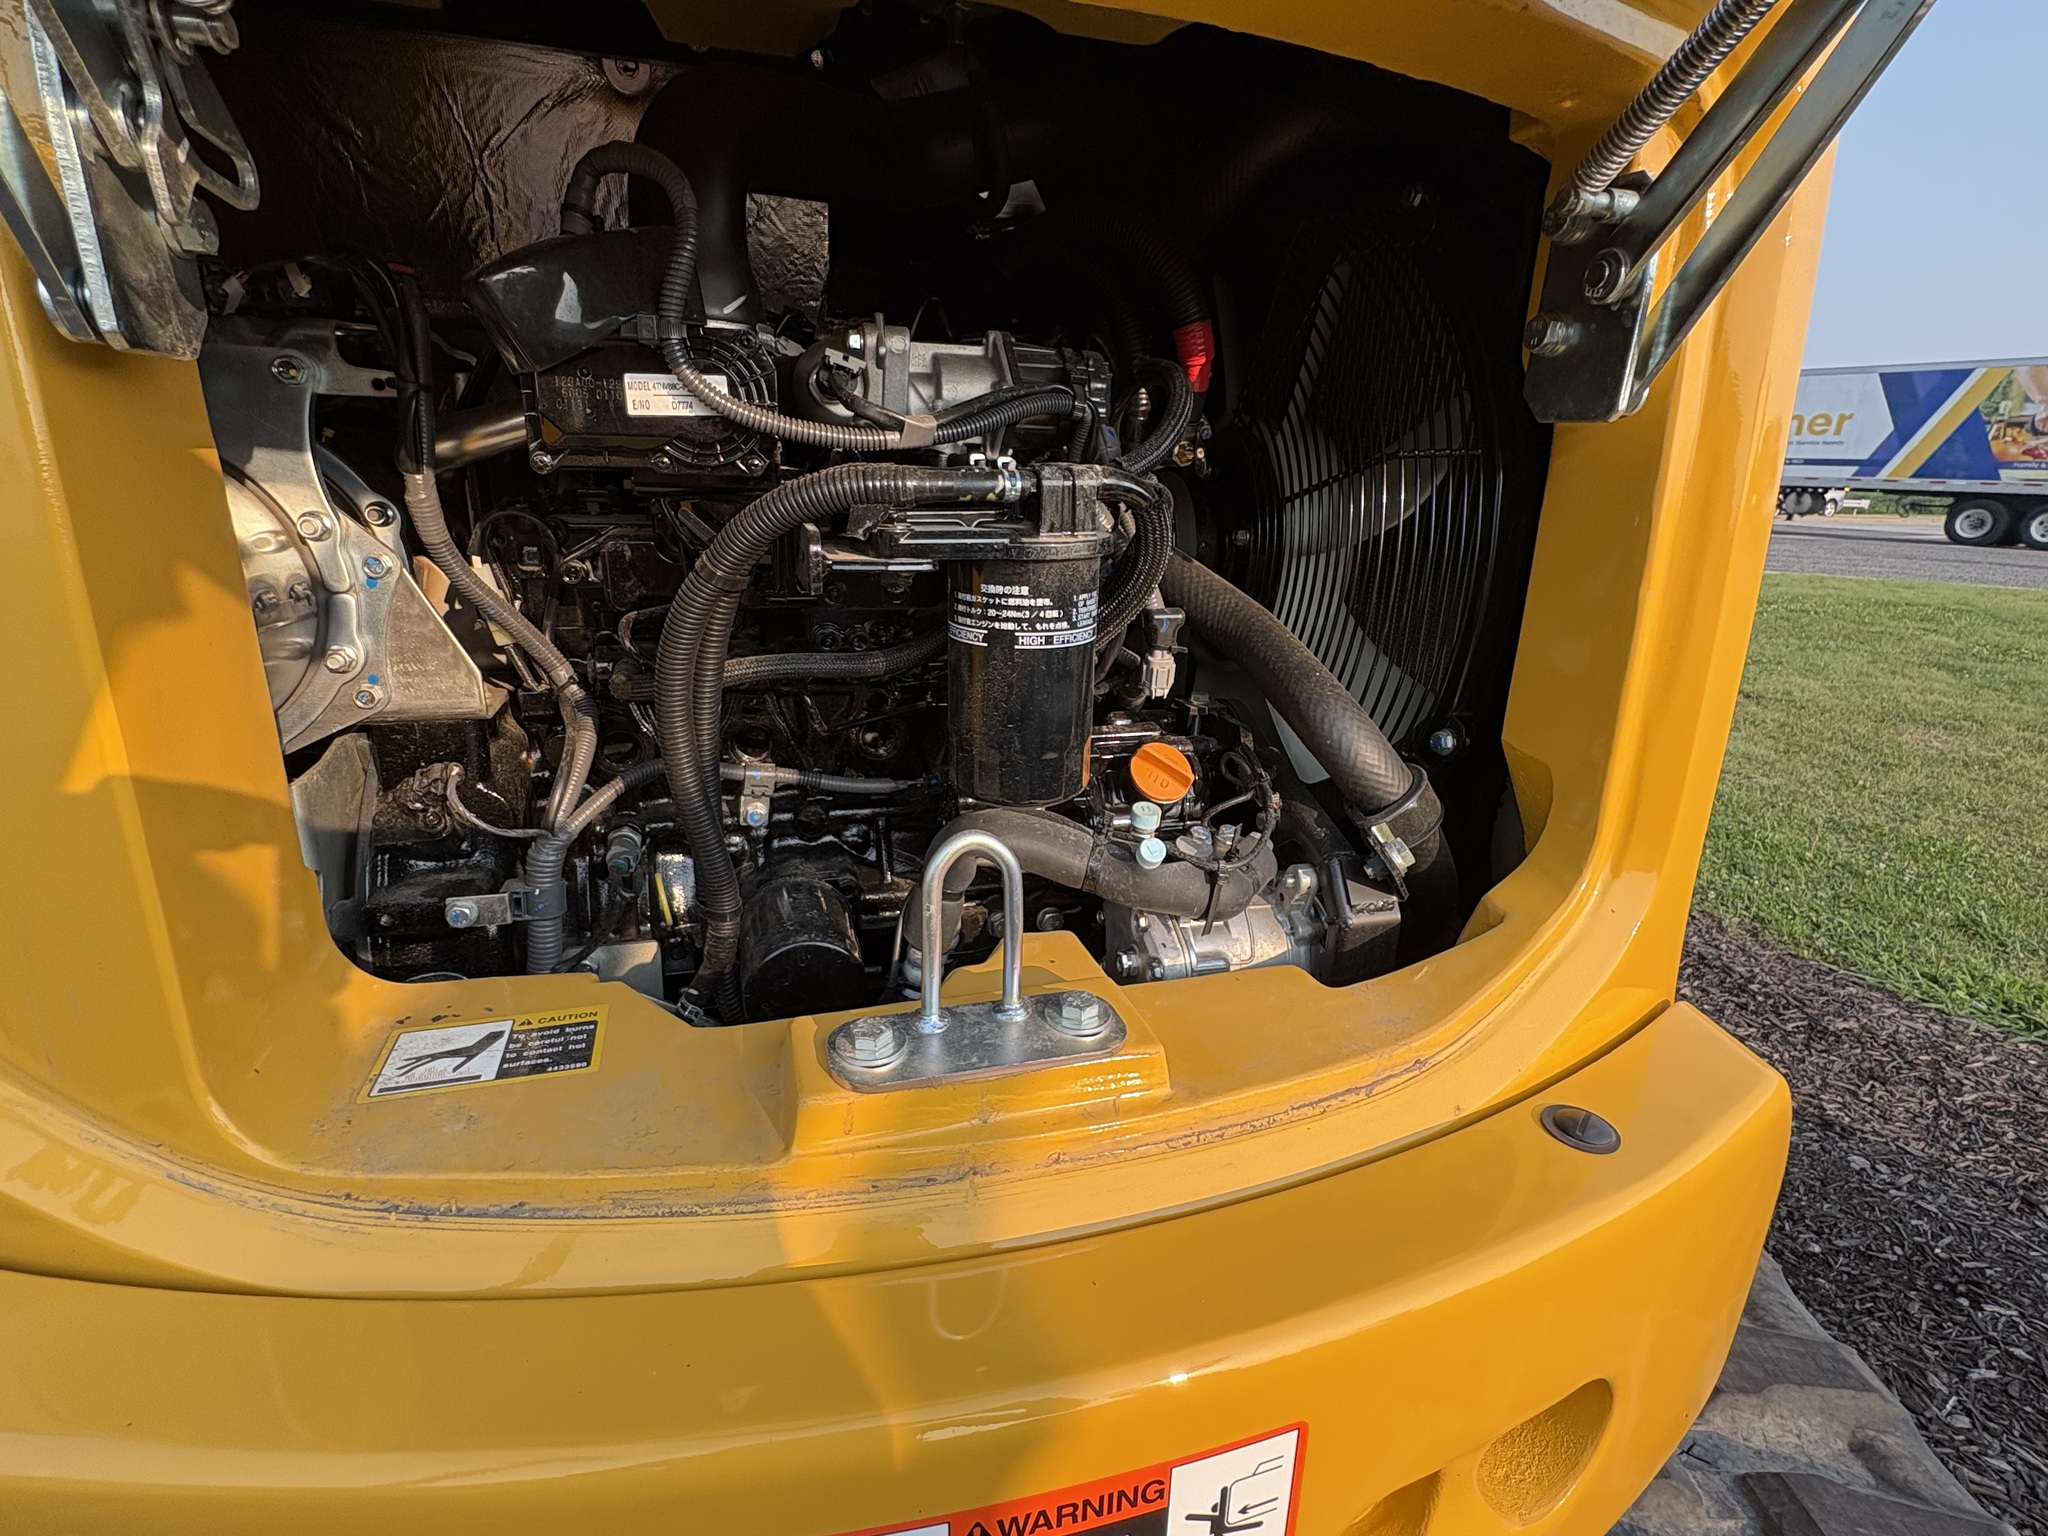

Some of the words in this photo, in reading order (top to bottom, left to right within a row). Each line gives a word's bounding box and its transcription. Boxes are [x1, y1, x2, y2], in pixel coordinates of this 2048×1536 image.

[627, 381, 651, 391] MODEL
[632, 399, 651, 411] E/NO
[1018, 635, 1046, 646] HIGH
[1052, 629, 1094, 645] EFFICIENCY
[537, 1011, 598, 1024] CAUTION
[512, 1032, 526, 1040] To
[530, 1028, 560, 1038] avoid
[565, 1024, 595, 1033] burns
[528, 1036, 565, 1047] careful
[569, 1033, 588, 1041] not
[522, 1046, 563, 1057] contact
[568, 1042, 586, 1050] hot
[502, 1057, 553, 1069] surfaces.
[996, 1479, 1166, 1536] WARNING
